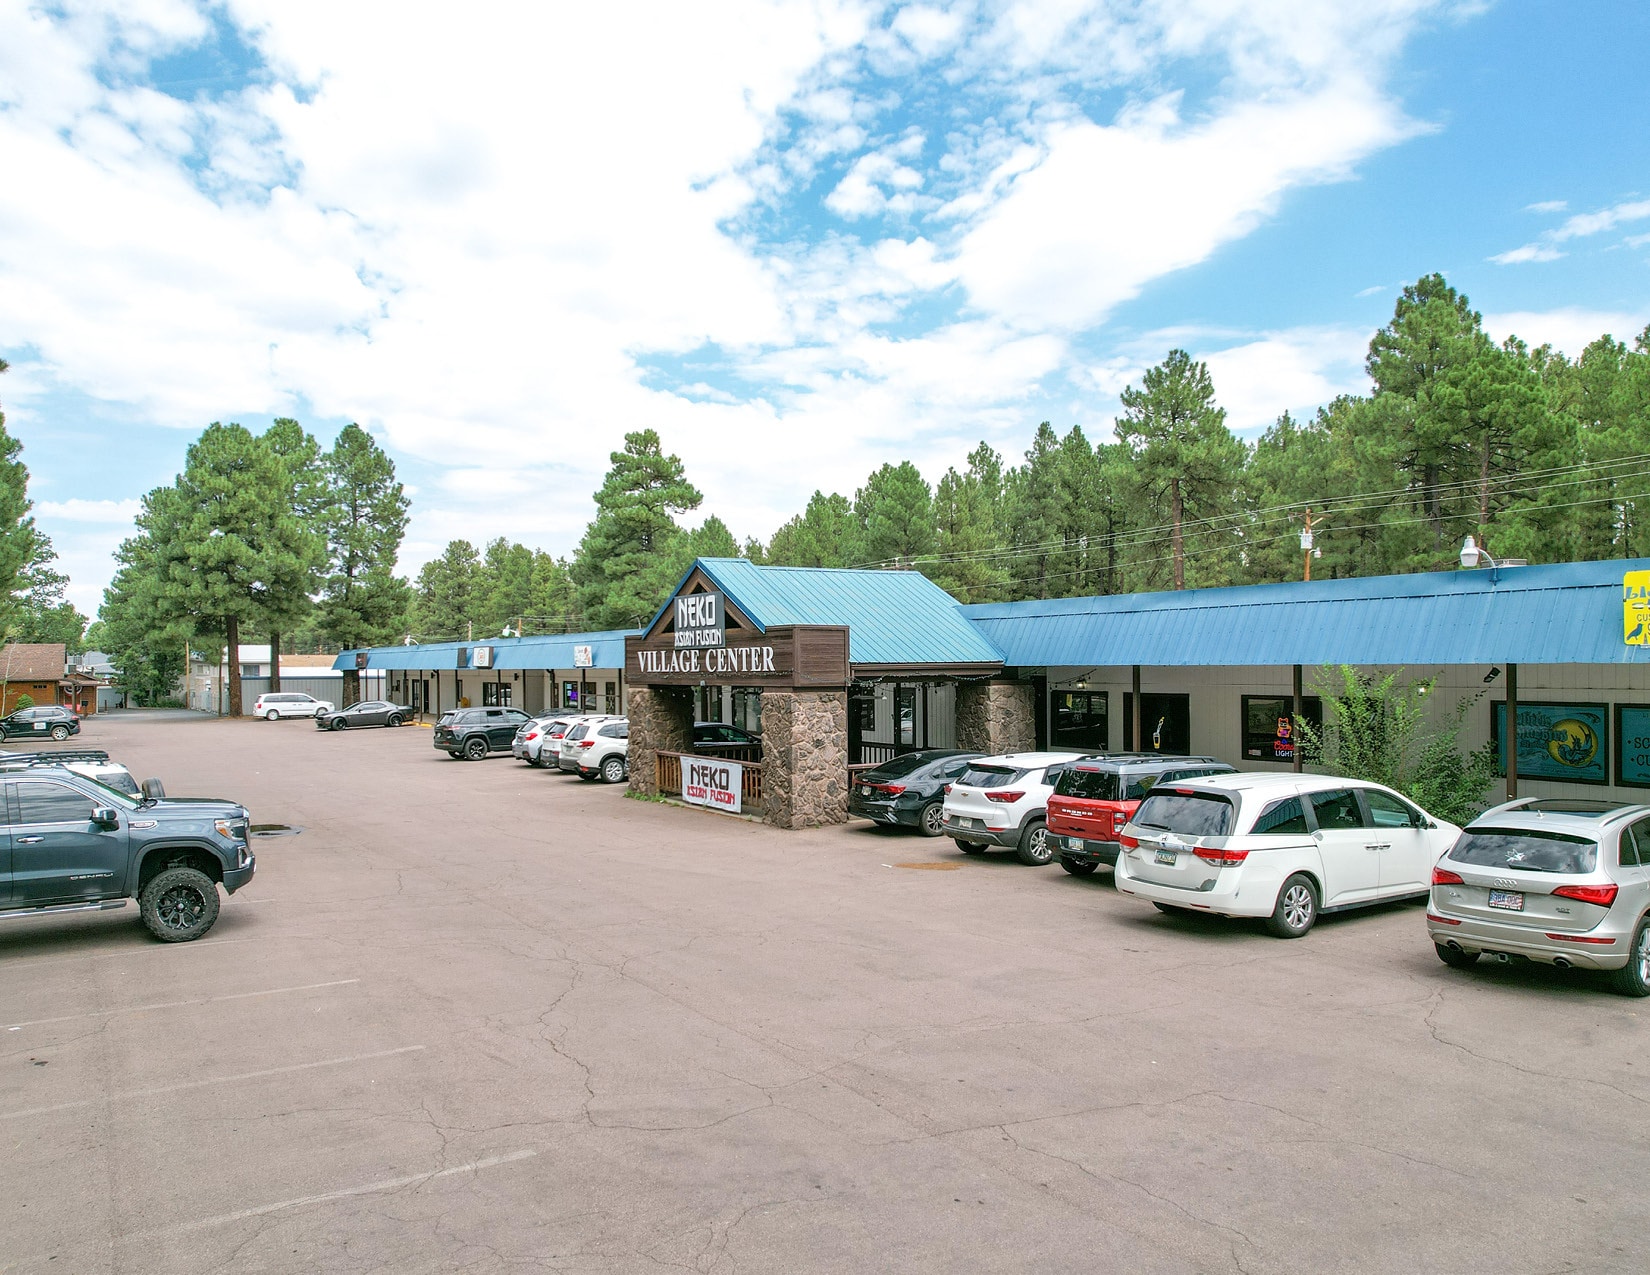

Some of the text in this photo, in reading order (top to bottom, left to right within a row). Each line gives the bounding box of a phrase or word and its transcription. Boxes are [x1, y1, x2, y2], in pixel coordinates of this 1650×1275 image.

[677, 594, 717, 629] NEKO
[674, 628, 722, 648] ASIAN FUSION
[637, 645, 776, 673] VILLAGE CENTER
[690, 763, 730, 791] NEKO
[686, 784, 736, 806] ASIAN FUSION
